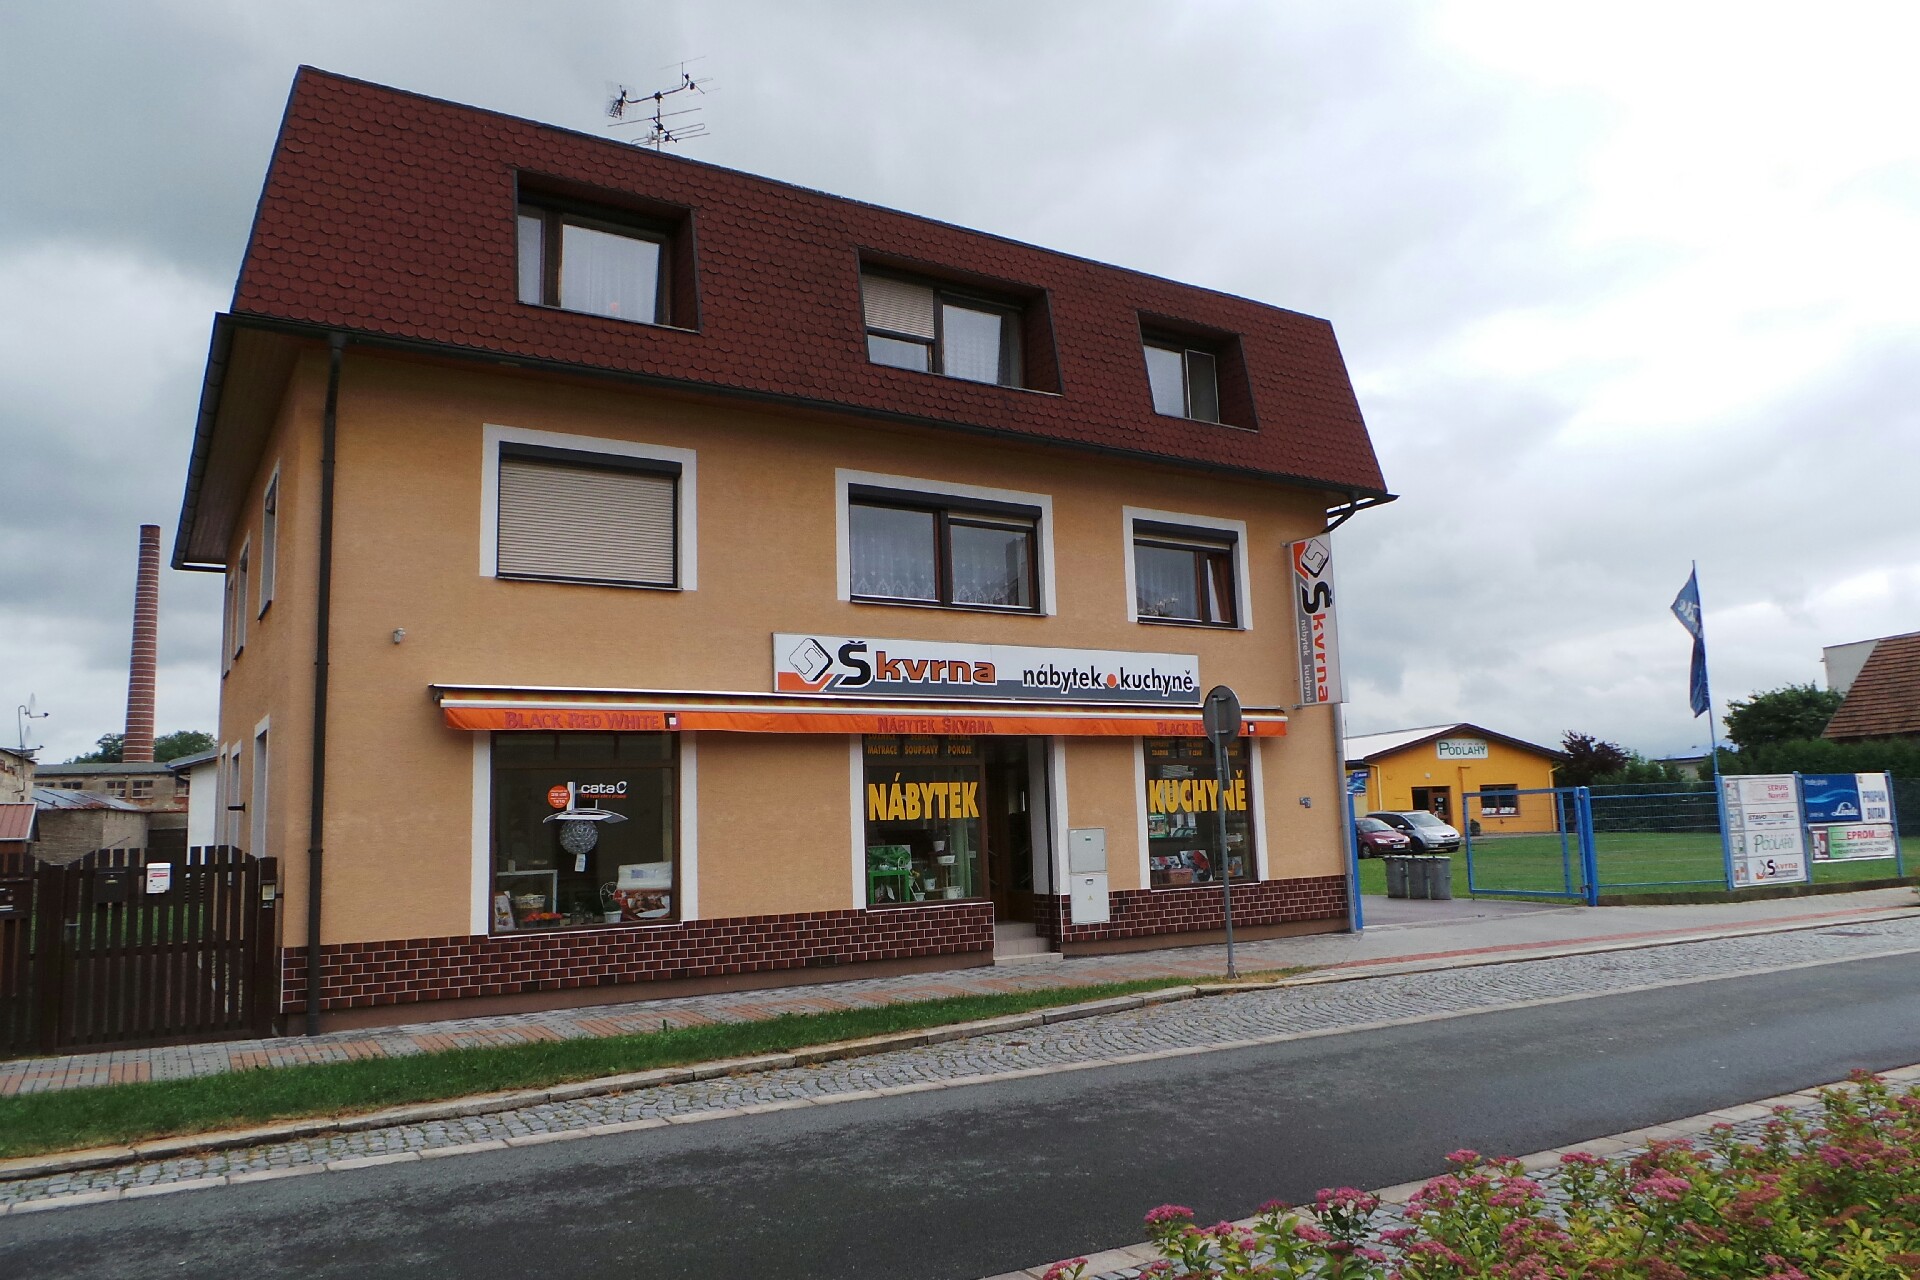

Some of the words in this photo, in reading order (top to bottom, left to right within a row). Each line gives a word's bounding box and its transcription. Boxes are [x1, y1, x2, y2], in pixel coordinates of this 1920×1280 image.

[1300, 579, 1334, 703] Škvrna
[836, 639, 997, 687] Škvrna
[1022, 663, 1103, 695] nábytek
[1118, 666, 1195, 697] kuchyně
[504, 711, 561, 729] BLACK
[568, 712, 602, 729] RED
[606, 713, 660, 730] WHITE
[877, 716, 935, 733] NÁBYTEK
[1438, 742, 1486, 756] PODLAHY
[580, 783, 615, 794] cata
[867, 772, 980, 821] NÁBYTEK
[1148, 769, 1247, 814] KUCHYNĚ
[1767, 784, 1789, 792] SERVIS
[1753, 833, 1795, 853] PODLAHY
[1846, 830, 1875, 840] EPROM
